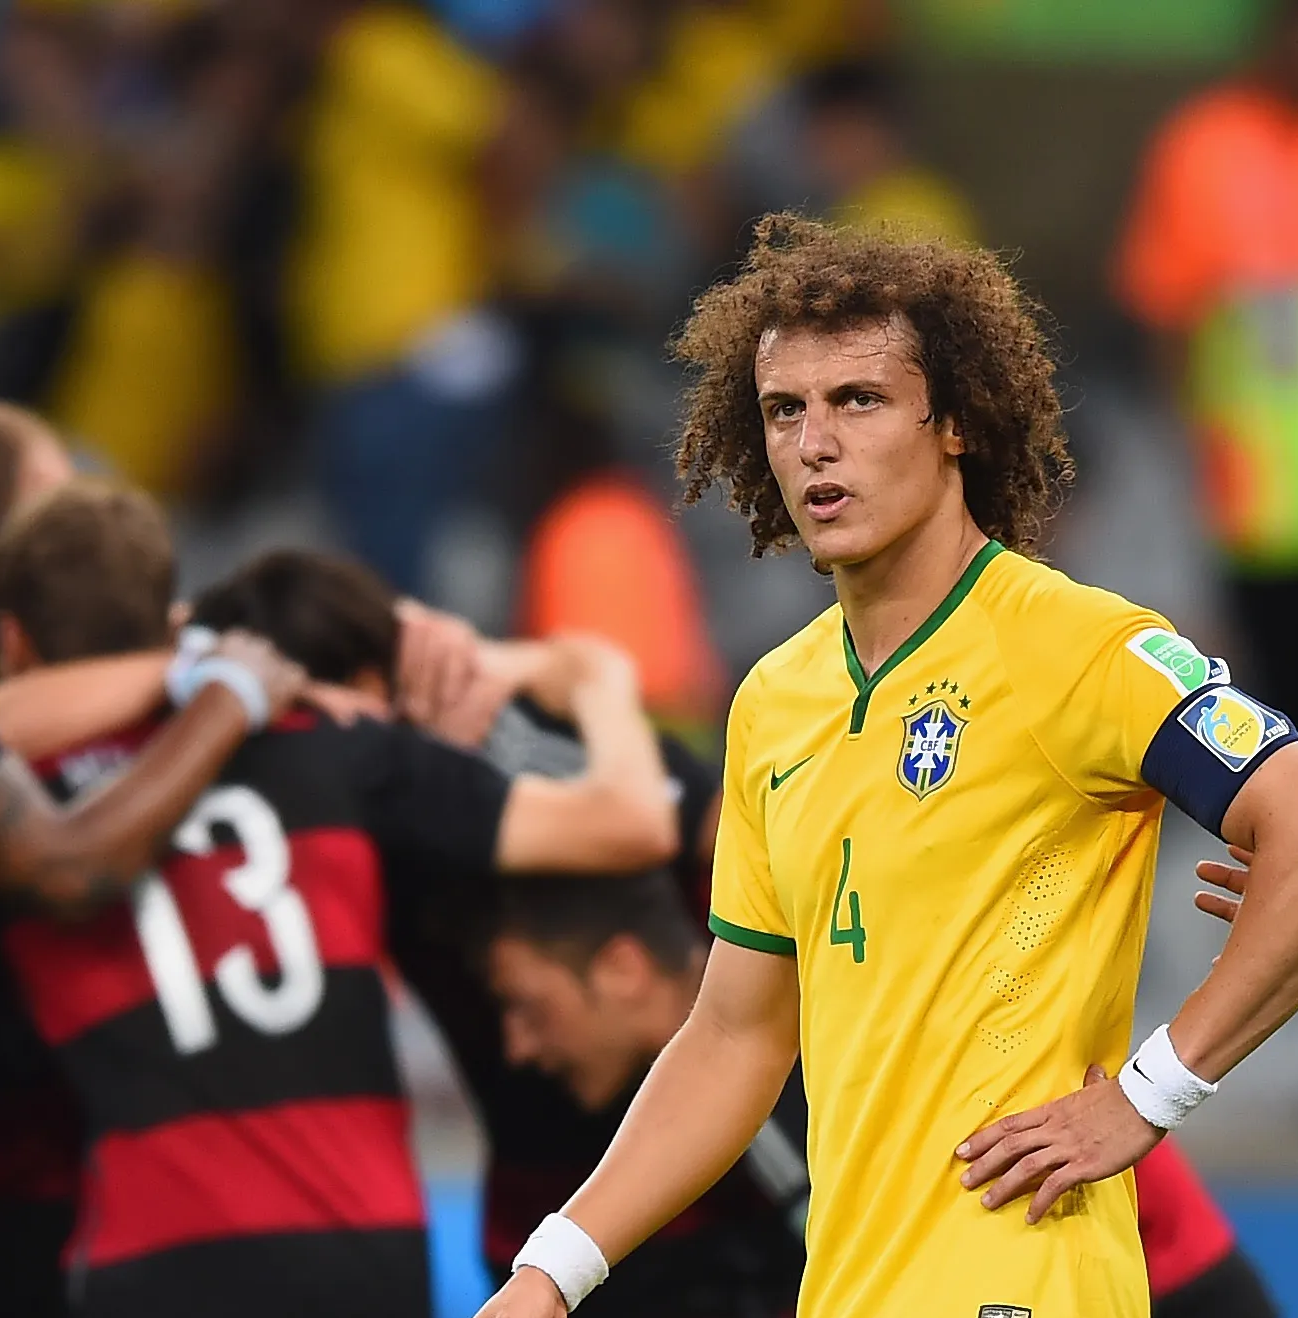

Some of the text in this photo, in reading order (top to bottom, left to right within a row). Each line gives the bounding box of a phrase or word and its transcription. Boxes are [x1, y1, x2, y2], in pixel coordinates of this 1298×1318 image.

[920, 740, 939, 752] CBF
[131, 783, 327, 1054] 13
[830, 837, 867, 964] 4
